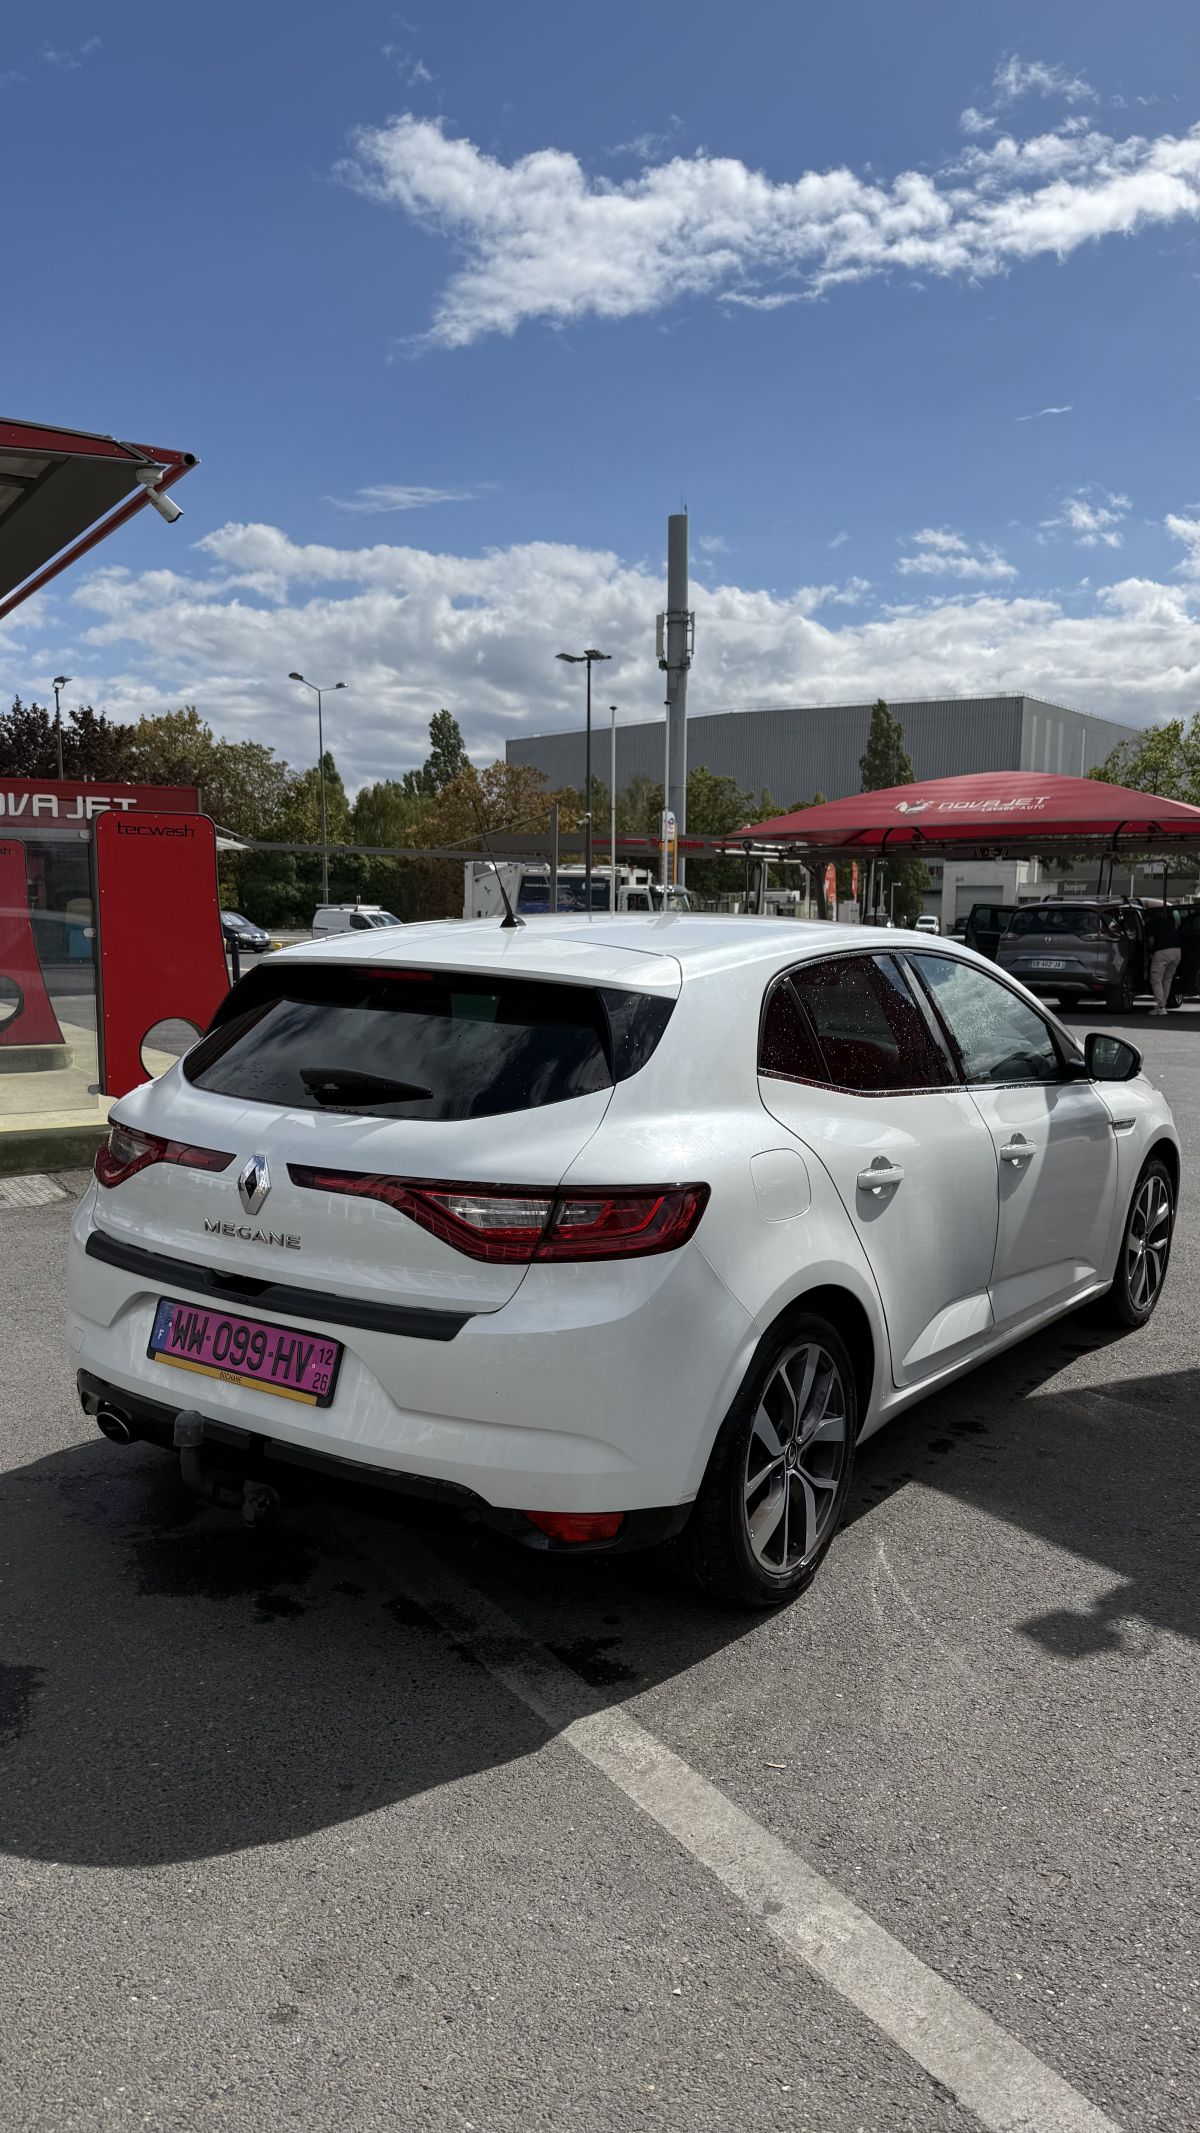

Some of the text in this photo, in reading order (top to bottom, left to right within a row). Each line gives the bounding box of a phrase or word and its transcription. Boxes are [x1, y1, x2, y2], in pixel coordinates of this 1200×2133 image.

[116, 821, 195, 838] tecwash
[204, 1218, 301, 1250] MEGANE
[157, 1329, 165, 1341] F
[319, 1346, 334, 1366] 12
[312, 1372, 329, 1391] 26
